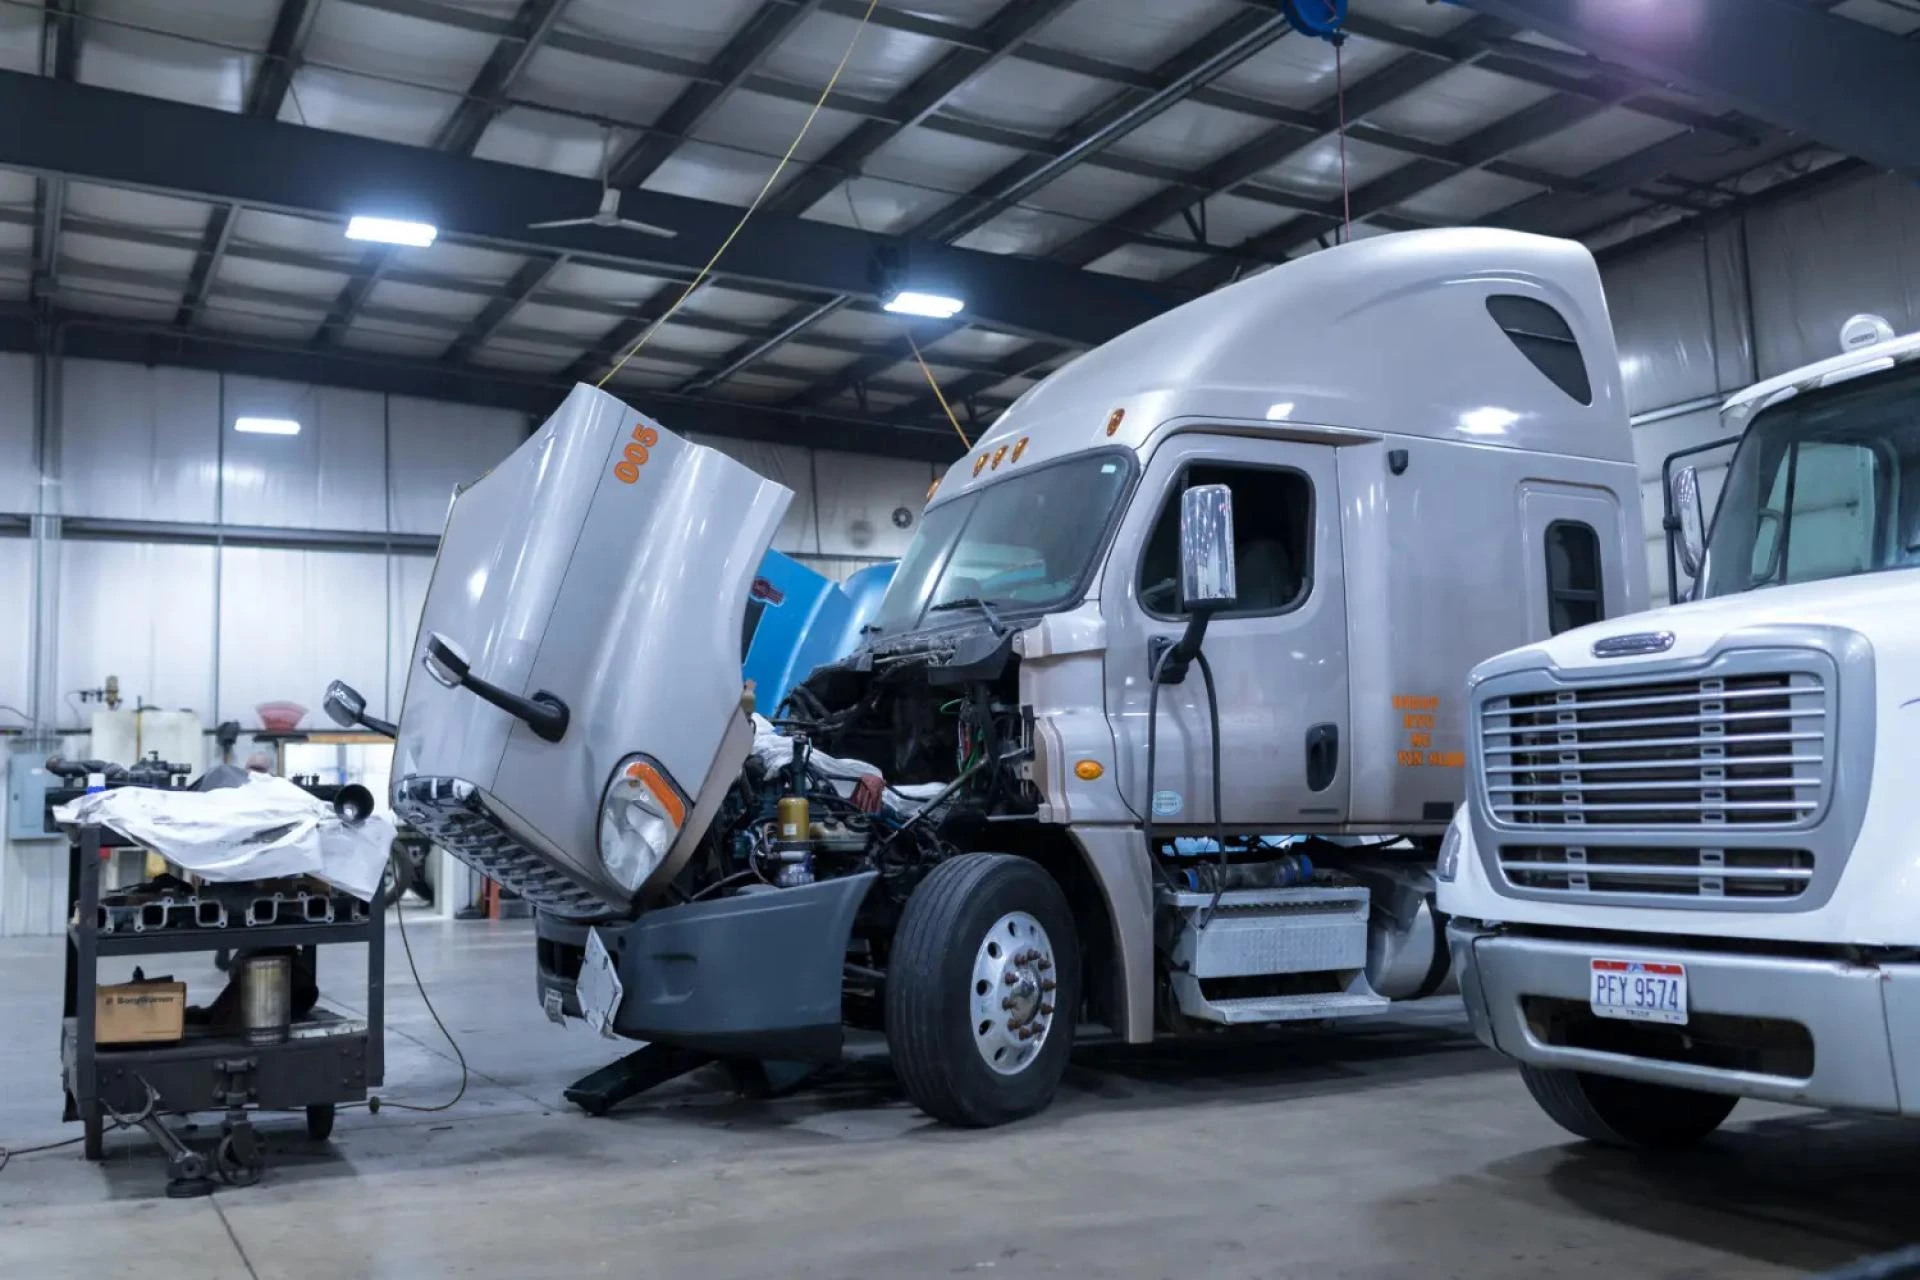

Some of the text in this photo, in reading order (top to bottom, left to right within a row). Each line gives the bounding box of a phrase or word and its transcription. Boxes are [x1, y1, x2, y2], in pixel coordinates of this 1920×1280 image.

[614, 423, 658, 484] 005
[1597, 974, 1679, 1012] PFY 9574
